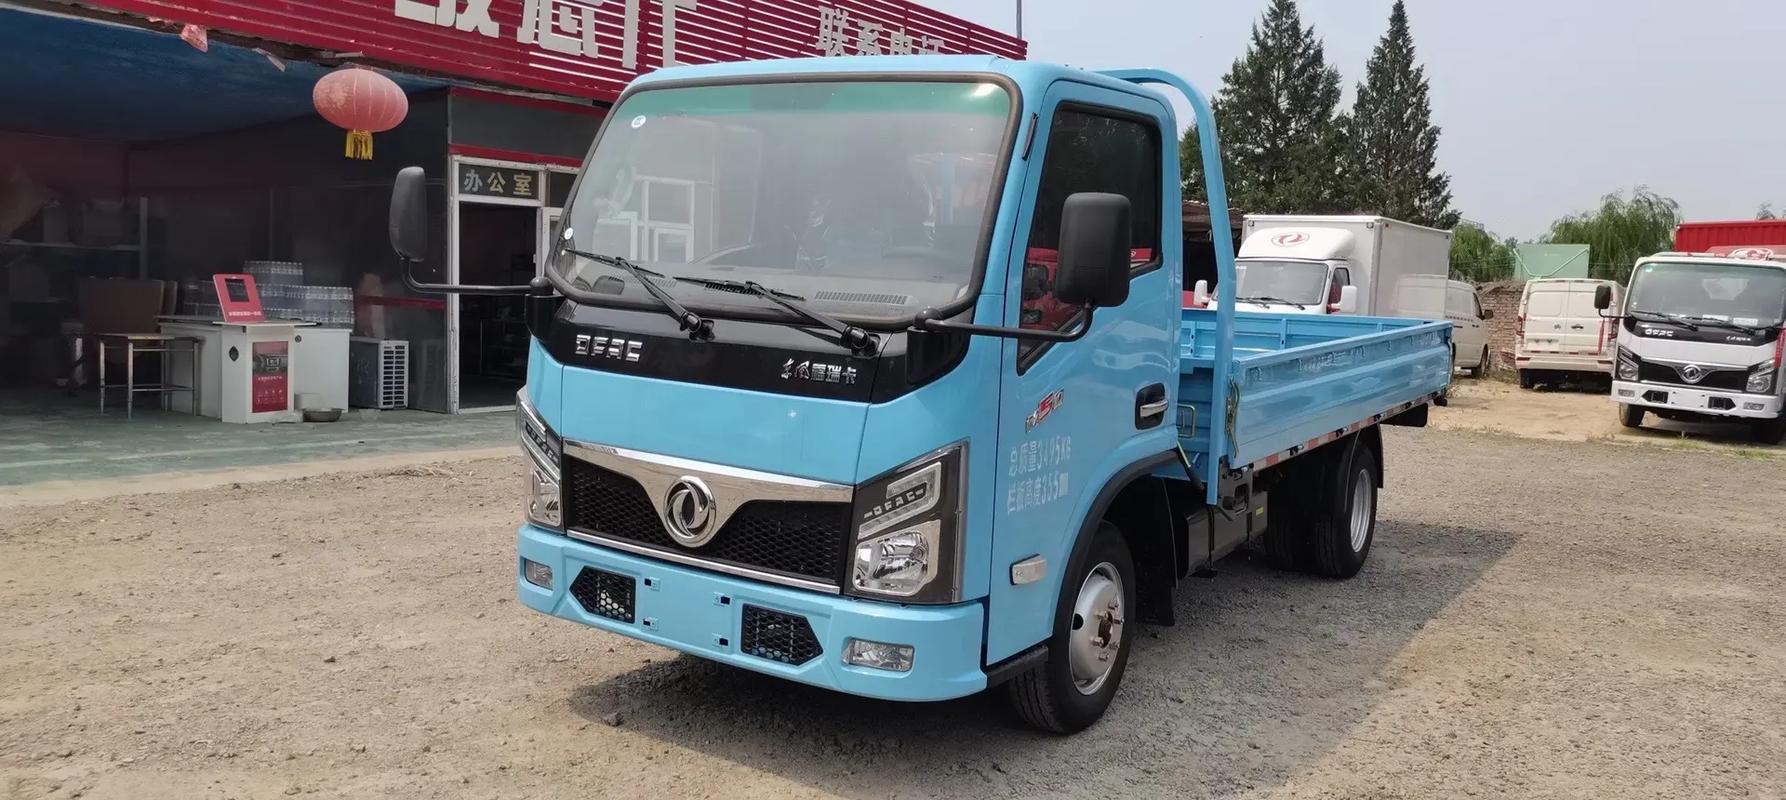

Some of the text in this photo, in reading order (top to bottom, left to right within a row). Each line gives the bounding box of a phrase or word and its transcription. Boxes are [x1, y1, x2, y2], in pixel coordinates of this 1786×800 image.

[464, 169, 532, 196] 办公室
[575, 334, 643, 362] DFAC
